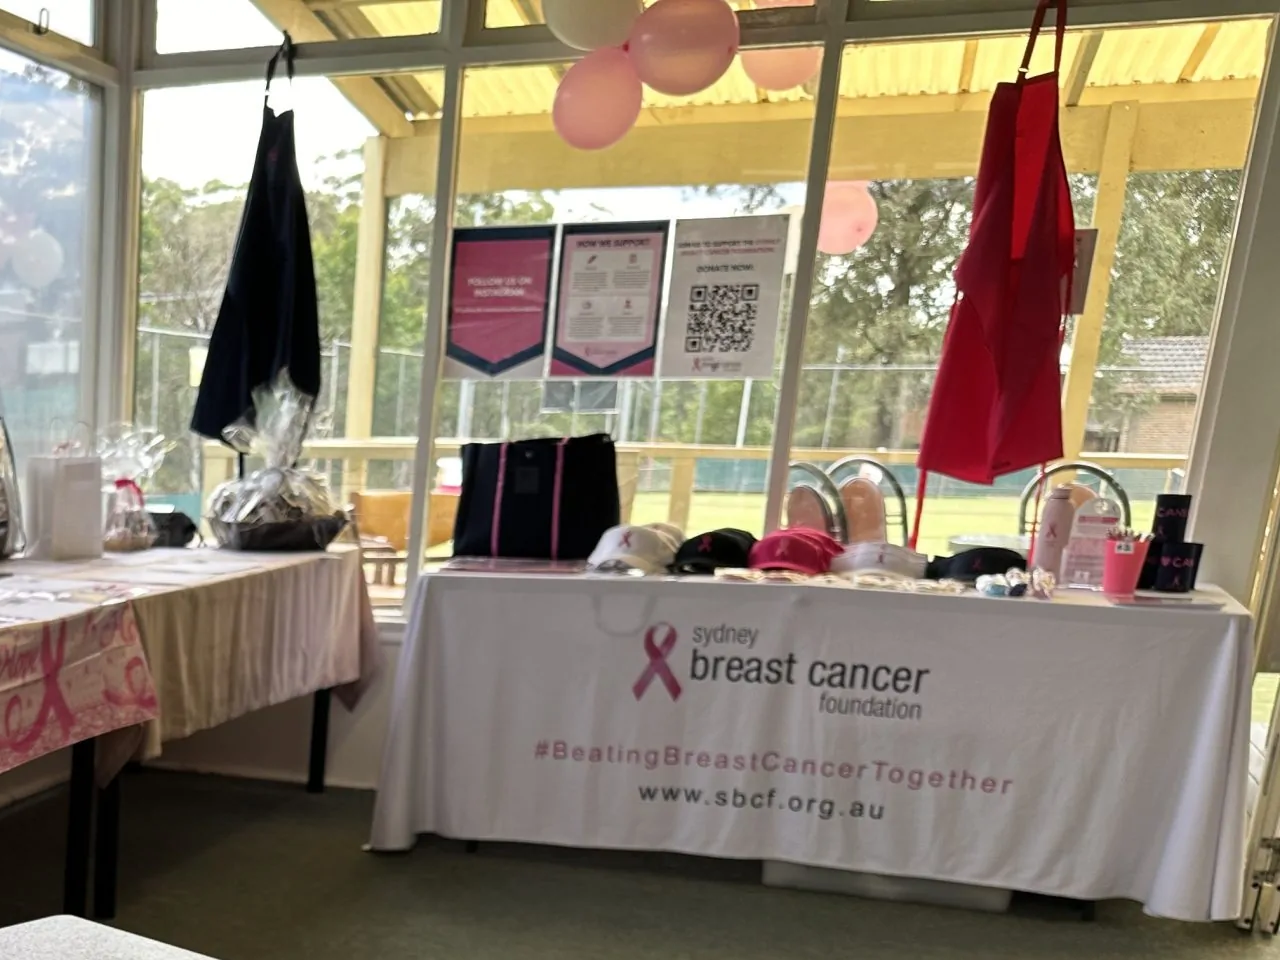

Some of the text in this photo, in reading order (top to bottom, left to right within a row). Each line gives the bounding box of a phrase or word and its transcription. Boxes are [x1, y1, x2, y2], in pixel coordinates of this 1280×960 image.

[692, 623, 759, 650] sydney
[690, 649, 931, 694] breast cancer
[819, 691, 923, 721] foundation
[533, 739, 1015, 796] #BeatingBreastCancerTogether
[638, 785, 886, 820] www.sbcf.org.au
